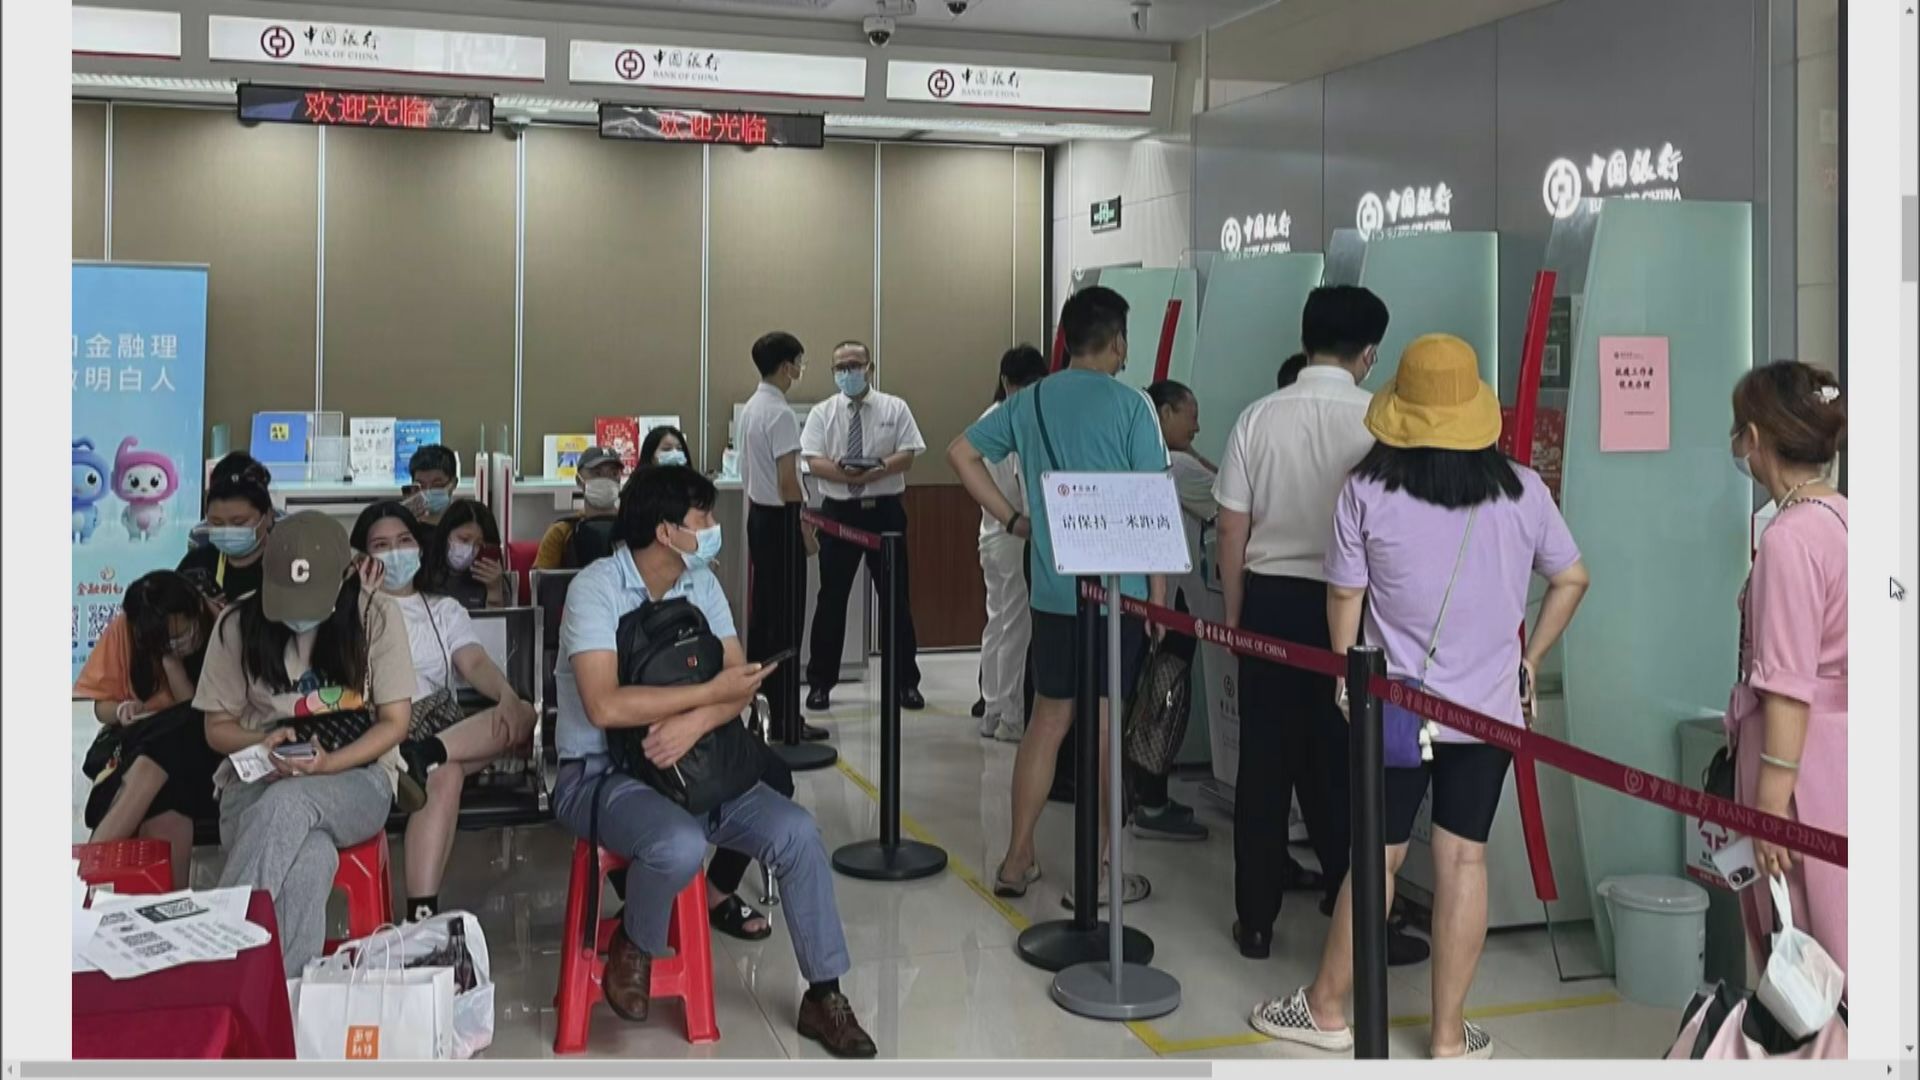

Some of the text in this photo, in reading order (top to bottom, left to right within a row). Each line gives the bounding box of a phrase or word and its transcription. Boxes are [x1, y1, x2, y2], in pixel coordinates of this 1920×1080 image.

[303, 25, 380, 50] 中国银行
[653, 48, 720, 72] 中国银行
[961, 67, 1021, 88] 中国银行
[304, 91, 428, 127] 欢迎光临
[659, 112, 767, 144] 欢迎光临
[1585, 142, 1683, 194] 中国银行
[1386, 181, 1453, 223] 中国银行
[1243, 209, 1291, 244] 中国银行
[1062, 513, 1171, 531] 请保持一米距离
[291, 559, 310, 583] C
[1264, 643, 1287, 659] CHINA
[1447, 710, 1473, 729] BANK
[1475, 718, 1489, 734] OF
[1489, 726, 1521, 748] CHINA
[1649, 777, 1838, 857] 中国银行 BANK OF CHINA
